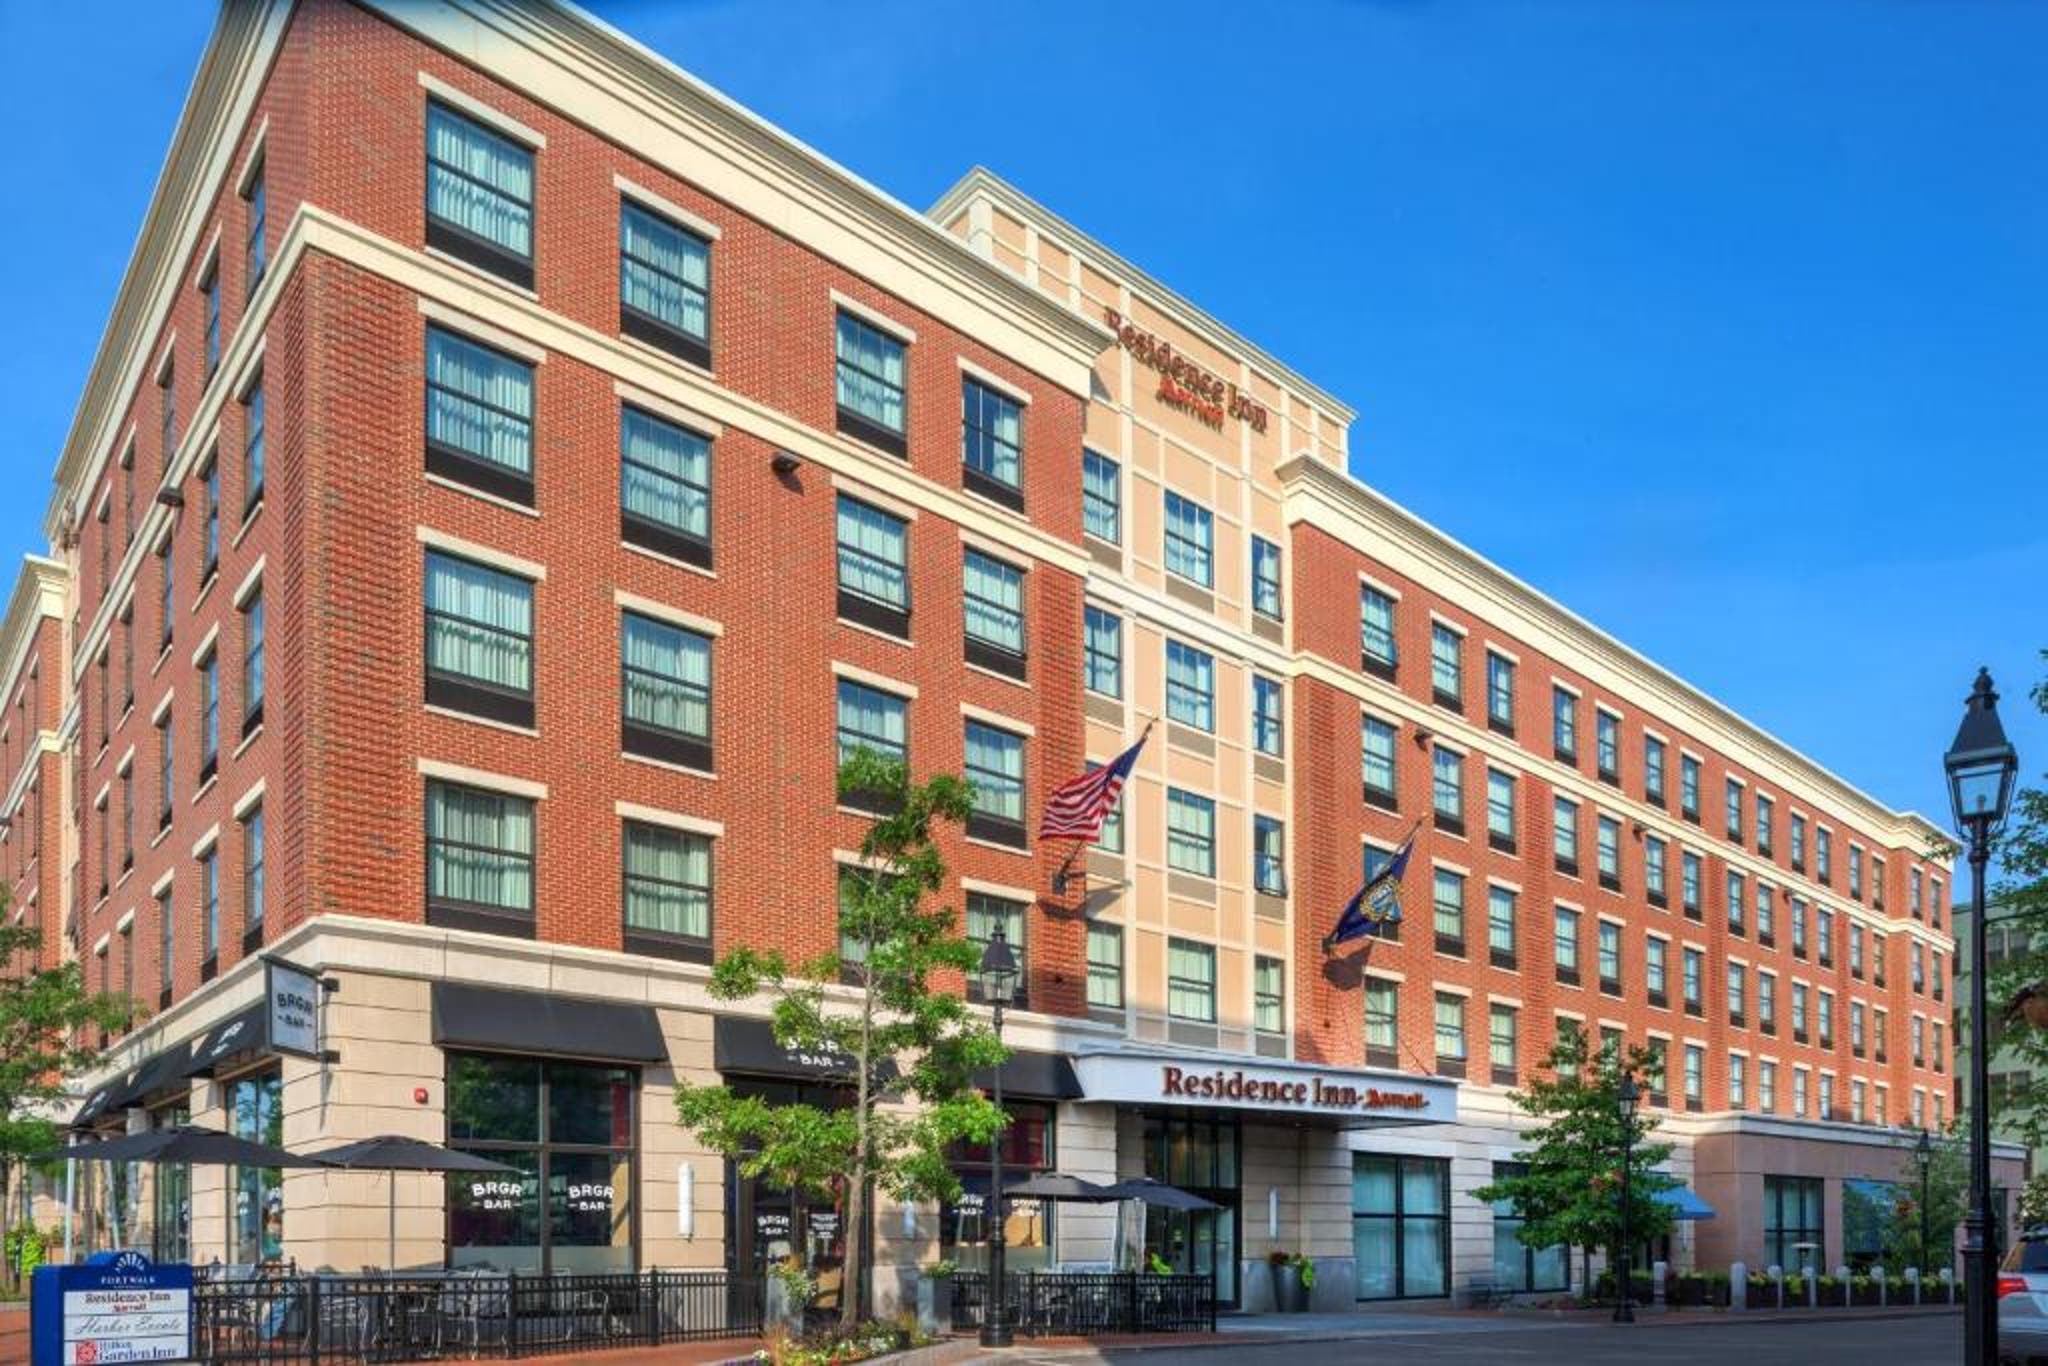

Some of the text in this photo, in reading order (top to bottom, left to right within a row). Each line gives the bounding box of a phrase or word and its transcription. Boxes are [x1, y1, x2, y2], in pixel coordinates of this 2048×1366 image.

[1104, 306, 1268, 434] Residence Inn
[277, 993, 313, 1015] BRGR
[800, 1053, 833, 1067] BAR
[1162, 1066, 1357, 1107] Residence Inn
[471, 1181, 522, 1197] BRGR
[568, 1184, 615, 1199] BRGR
[483, 1199, 512, 1210] BAR
[579, 1201, 606, 1212] BAR
[85, 1291, 171, 1304] Residence Inn
[99, 1346, 177, 1362] Garden Inn
